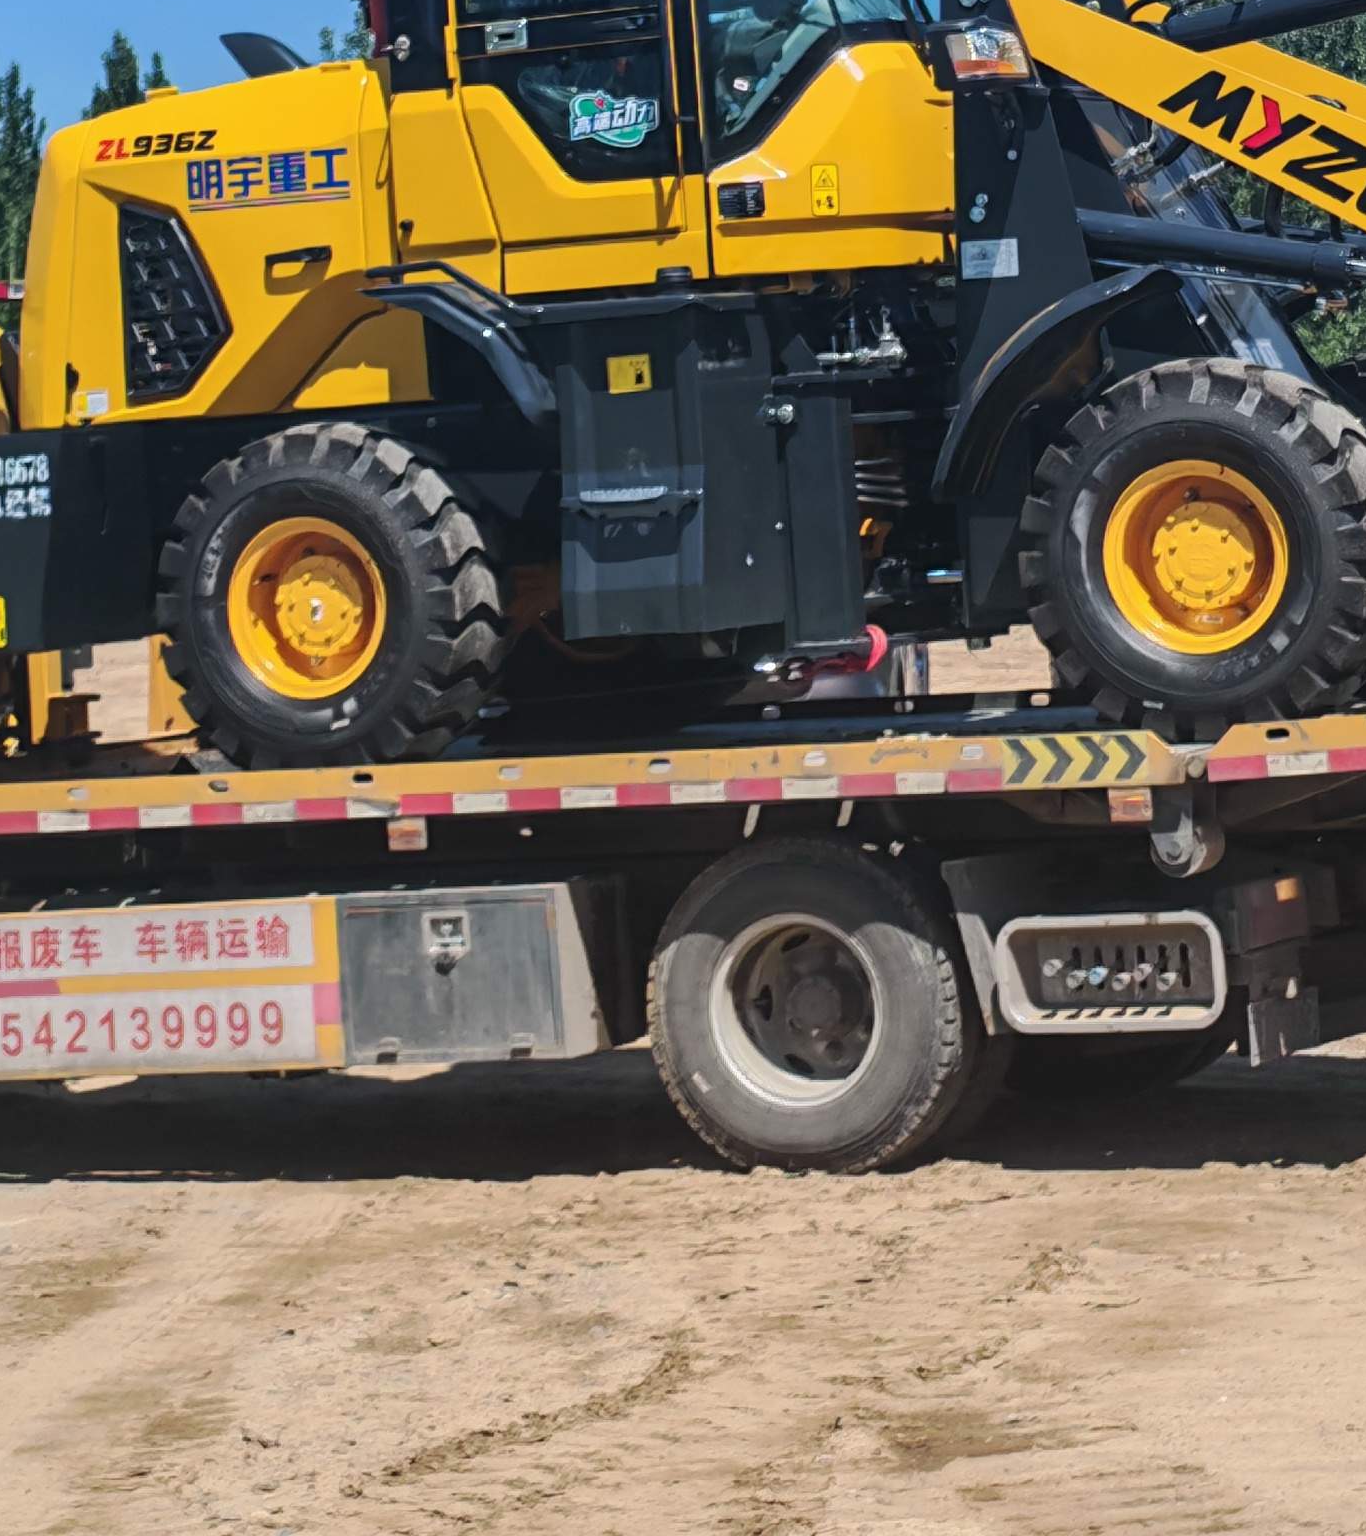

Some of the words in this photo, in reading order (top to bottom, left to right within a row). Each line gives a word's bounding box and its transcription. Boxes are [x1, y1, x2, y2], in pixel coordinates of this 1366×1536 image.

[95, 129, 217, 162] ZL936Z
[186, 147, 351, 201] 明宇重工
[135, 914, 291, 964] 车辆运输
